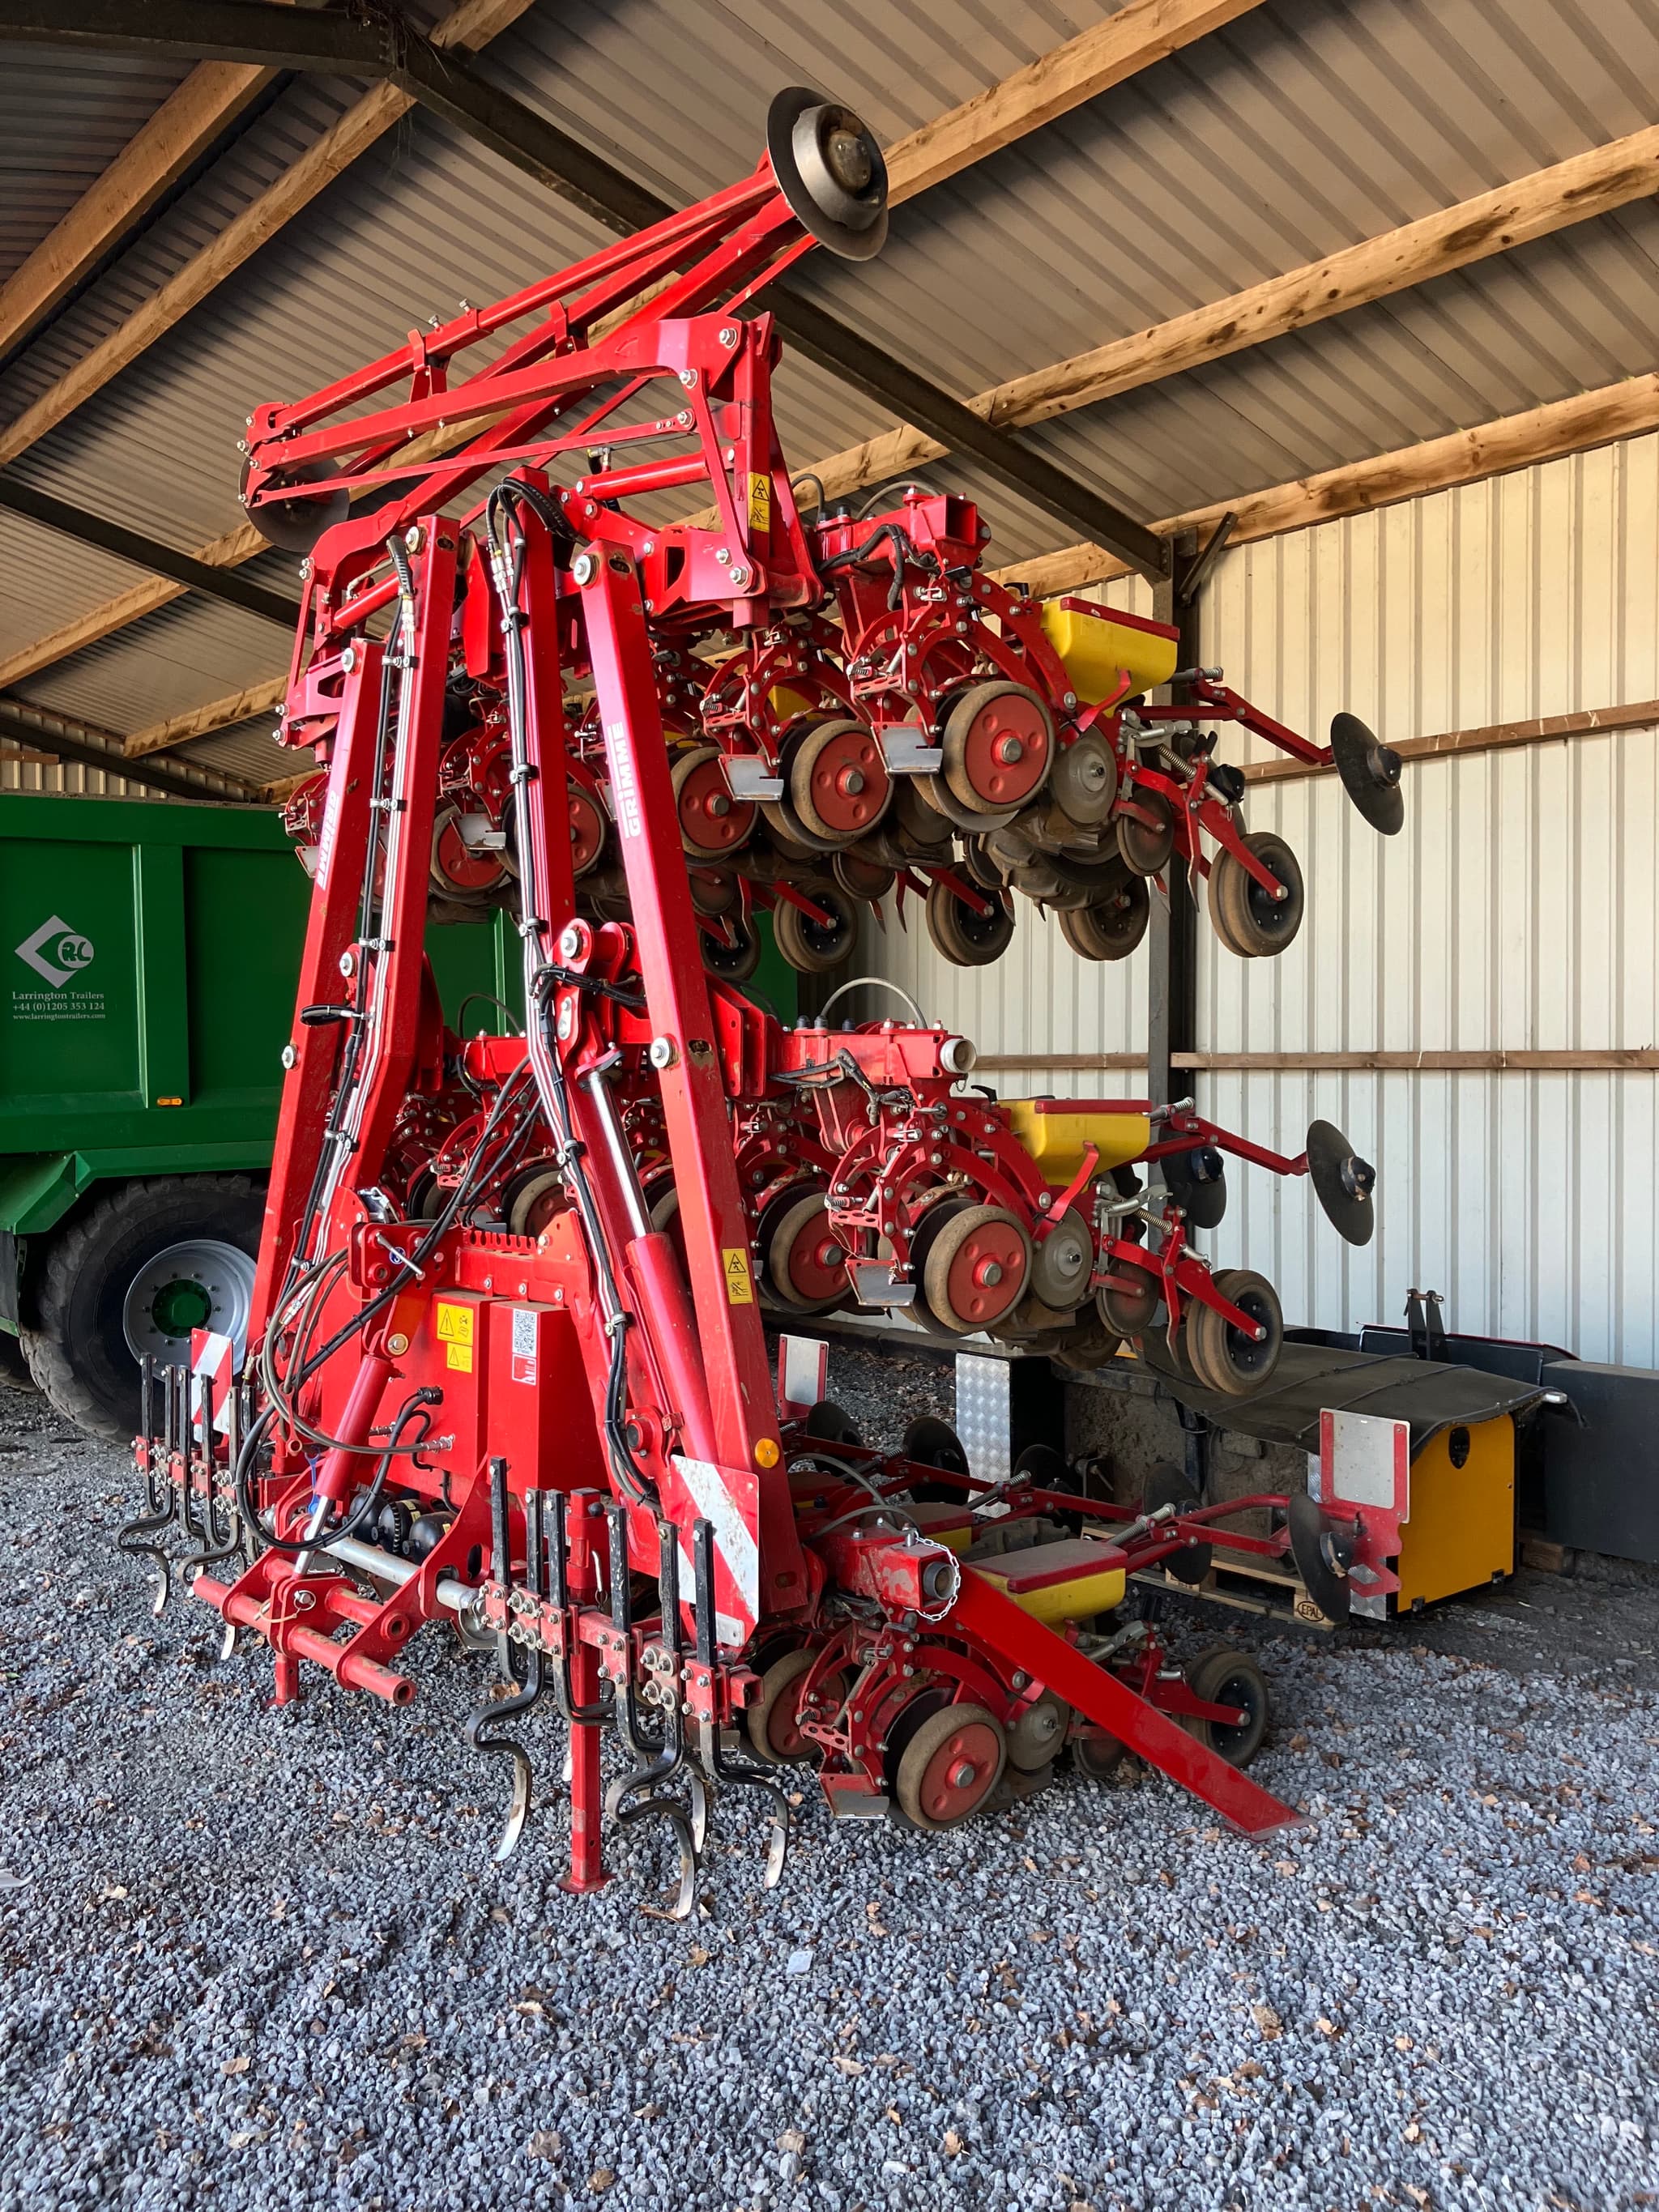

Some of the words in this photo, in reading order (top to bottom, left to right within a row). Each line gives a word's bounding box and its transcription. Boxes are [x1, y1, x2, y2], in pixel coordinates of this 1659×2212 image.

[12, 991, 67, 1001] Larrington
[70, 991, 104, 999] Trailers
[13, 1003, 30, 1011] +44
[32, 1002, 68, 1012] (0)1205
[70, 1002, 87, 1010] 353
[89, 1002, 104, 1010] 124
[1302, 1604, 1320, 1619] EPAL
